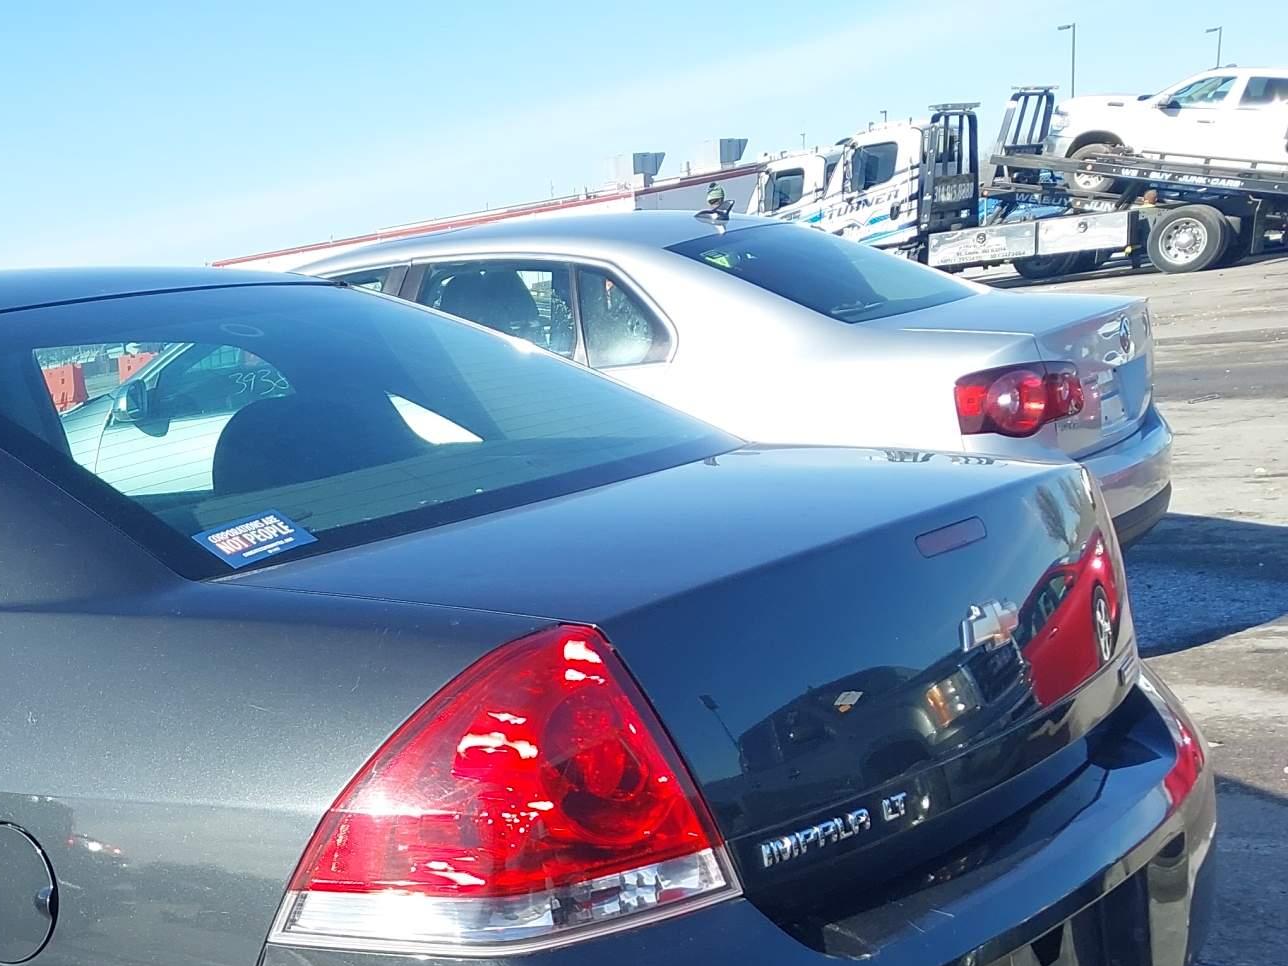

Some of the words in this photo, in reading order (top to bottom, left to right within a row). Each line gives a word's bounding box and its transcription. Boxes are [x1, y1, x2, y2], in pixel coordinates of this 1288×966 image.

[1149, 171, 1172, 180] BUY
[1178, 174, 1208, 184] JUNK
[1043, 195, 1070, 206] BUY
[1083, 200, 1117, 212] JUN
[207, 519, 264, 544] CORPORATIONS
[261, 514, 281, 526] ARE
[215, 535, 250, 555] NOT
[244, 521, 295, 545] PEOPLE
[760, 807, 871, 868] IMPALA
[881, 791, 907, 822] LT
